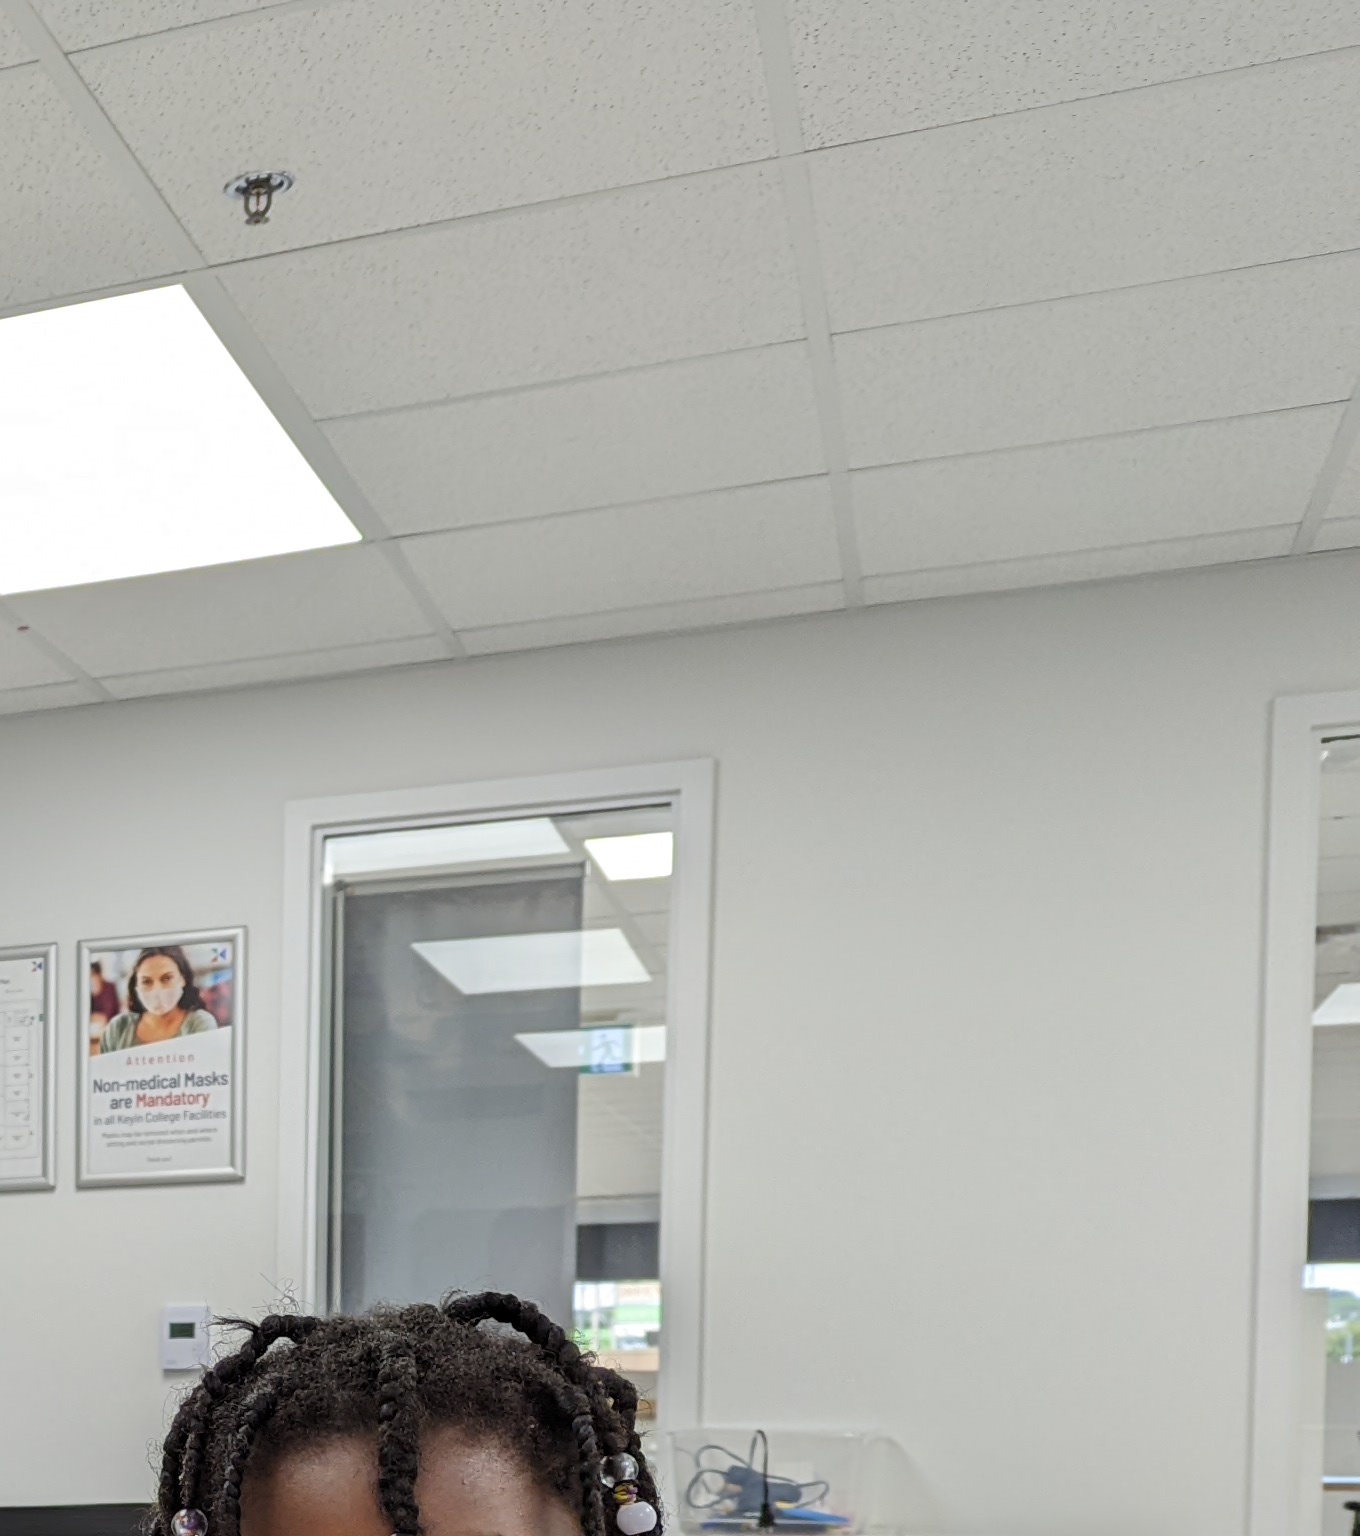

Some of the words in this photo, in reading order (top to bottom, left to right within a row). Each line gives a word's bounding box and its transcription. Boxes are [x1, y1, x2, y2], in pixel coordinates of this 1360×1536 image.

[126, 1053, 195, 1067] Attention
[93, 1073, 181, 1094] Non-medical
[184, 1071, 229, 1087] Masks
[109, 1097, 133, 1110] are
[135, 1092, 211, 1108] Mandatory
[93, 1115, 102, 1126] in
[104, 1115, 115, 1125] all
[145, 1112, 181, 1125] College
[183, 1110, 227, 1121] Facilities
